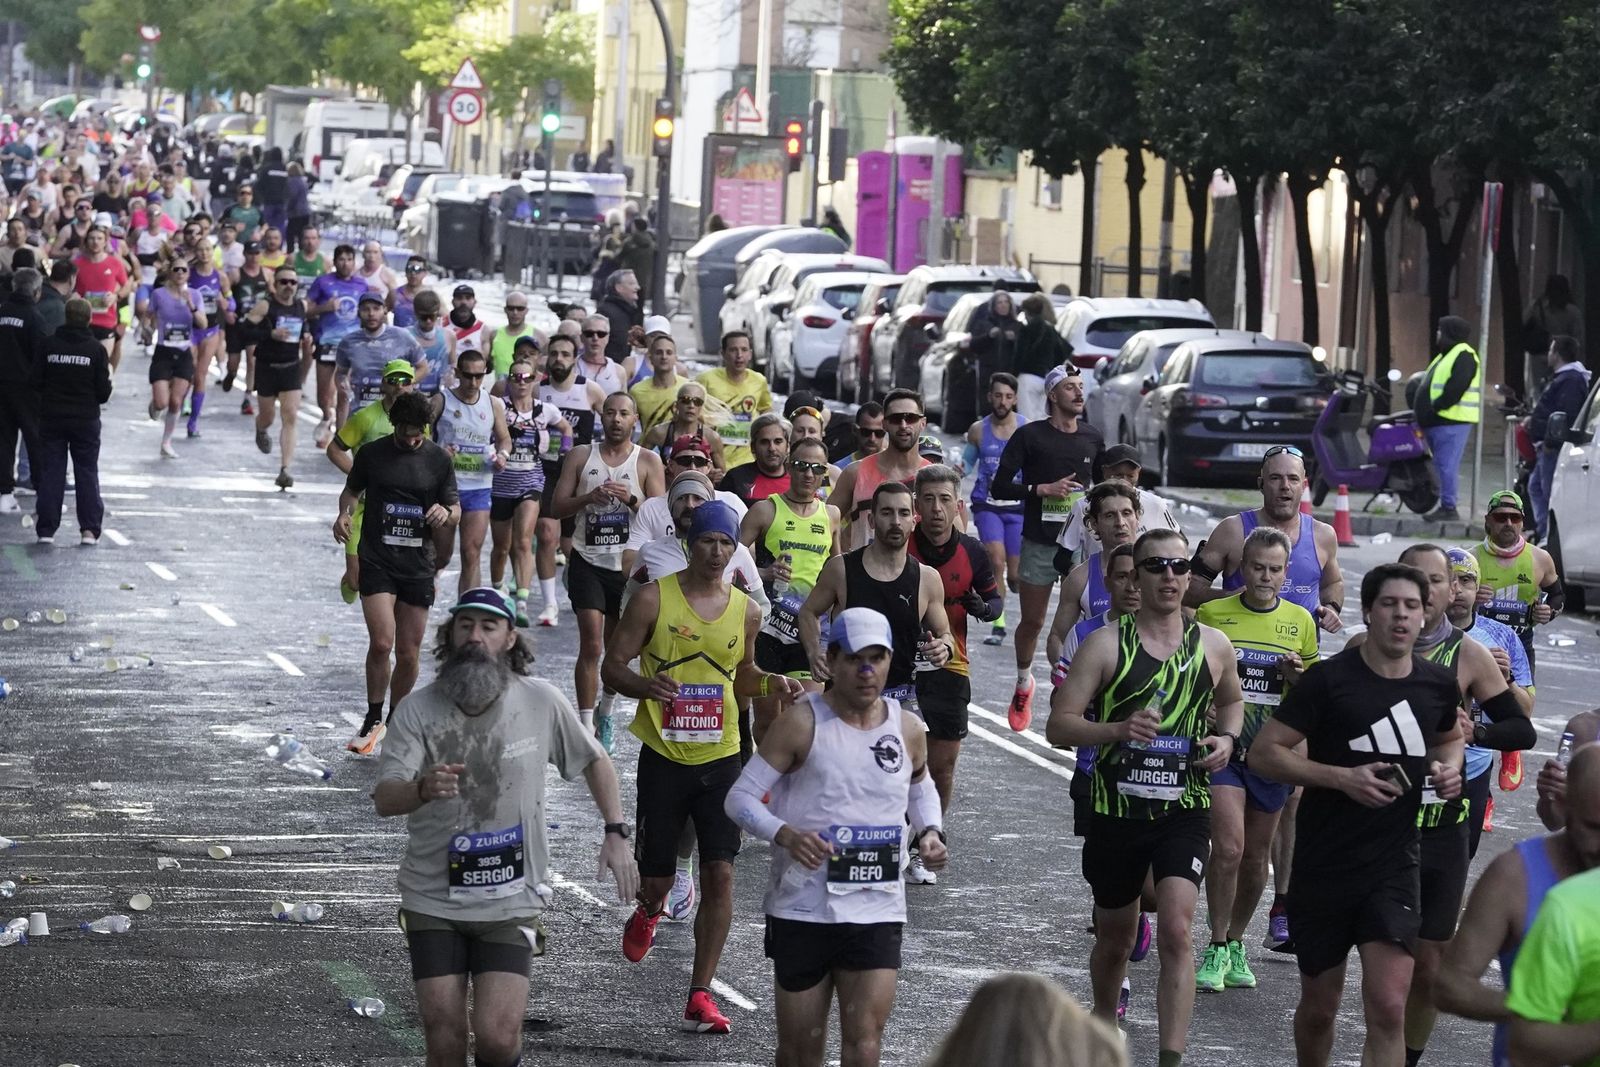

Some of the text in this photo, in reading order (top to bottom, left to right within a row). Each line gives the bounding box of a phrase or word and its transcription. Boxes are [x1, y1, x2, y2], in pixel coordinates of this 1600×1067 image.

[456, 101, 476, 114] 30
[47, 353, 91, 366] VOLUNTEER
[600, 513, 625, 522] ZURICH
[391, 526, 414, 537] FEDE
[594, 534, 620, 545] DIOGO
[784, 598, 800, 610] ZUR
[1496, 601, 1523, 609] ZURICH
[1246, 667, 1265, 677] 5008
[1241, 677, 1269, 692] KAKU
[684, 687, 718, 696] ZURICH
[684, 704, 704, 714] 1406
[669, 716, 719, 729] ANTONIO
[1151, 739, 1183, 750] URICH
[1143, 757, 1164, 768] 4904
[1127, 768, 1178, 786] JURGEN
[476, 831, 517, 848] ZURICH
[857, 829, 896, 841] ZURICH
[477, 855, 502, 867] 3935
[857, 851, 879, 862] 4721
[462, 865, 515, 885] SERGIO
[849, 865, 883, 881] REFO
